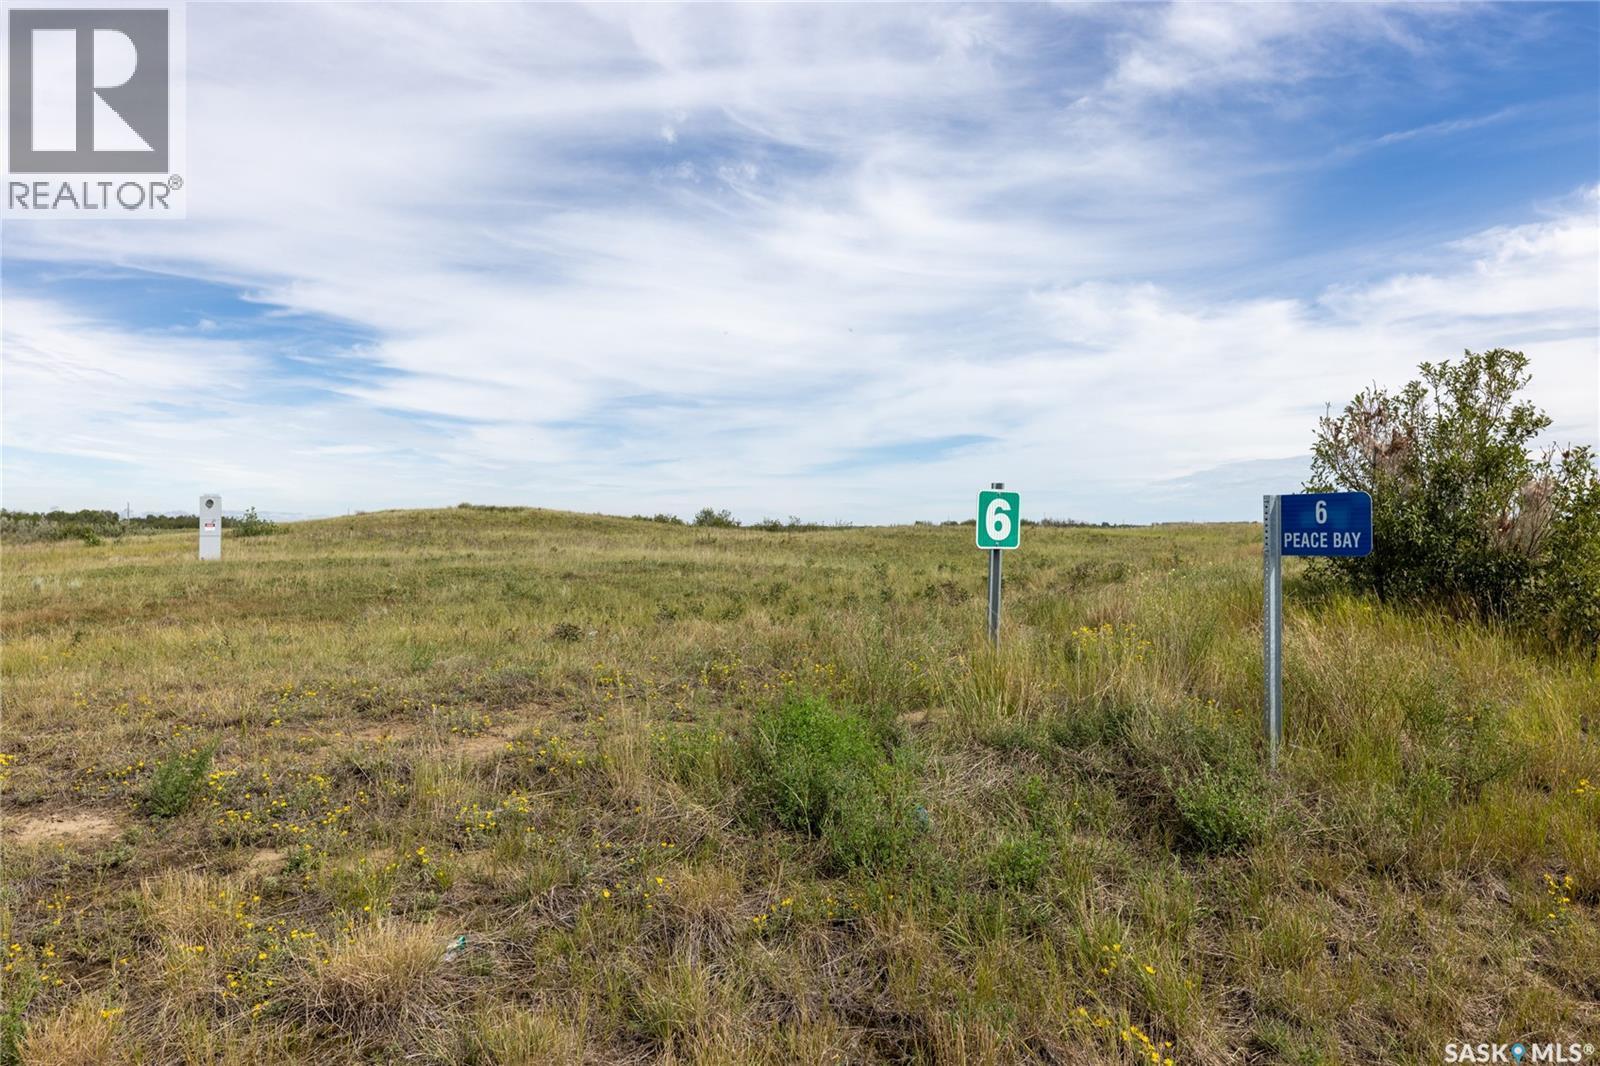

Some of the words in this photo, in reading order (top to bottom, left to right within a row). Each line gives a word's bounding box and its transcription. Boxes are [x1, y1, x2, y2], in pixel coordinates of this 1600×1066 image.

[985, 498, 1011, 541] 6
[1315, 500, 1328, 524] 6
[1284, 532, 1328, 548] PEACE
[1333, 532, 1361, 548] BAY
